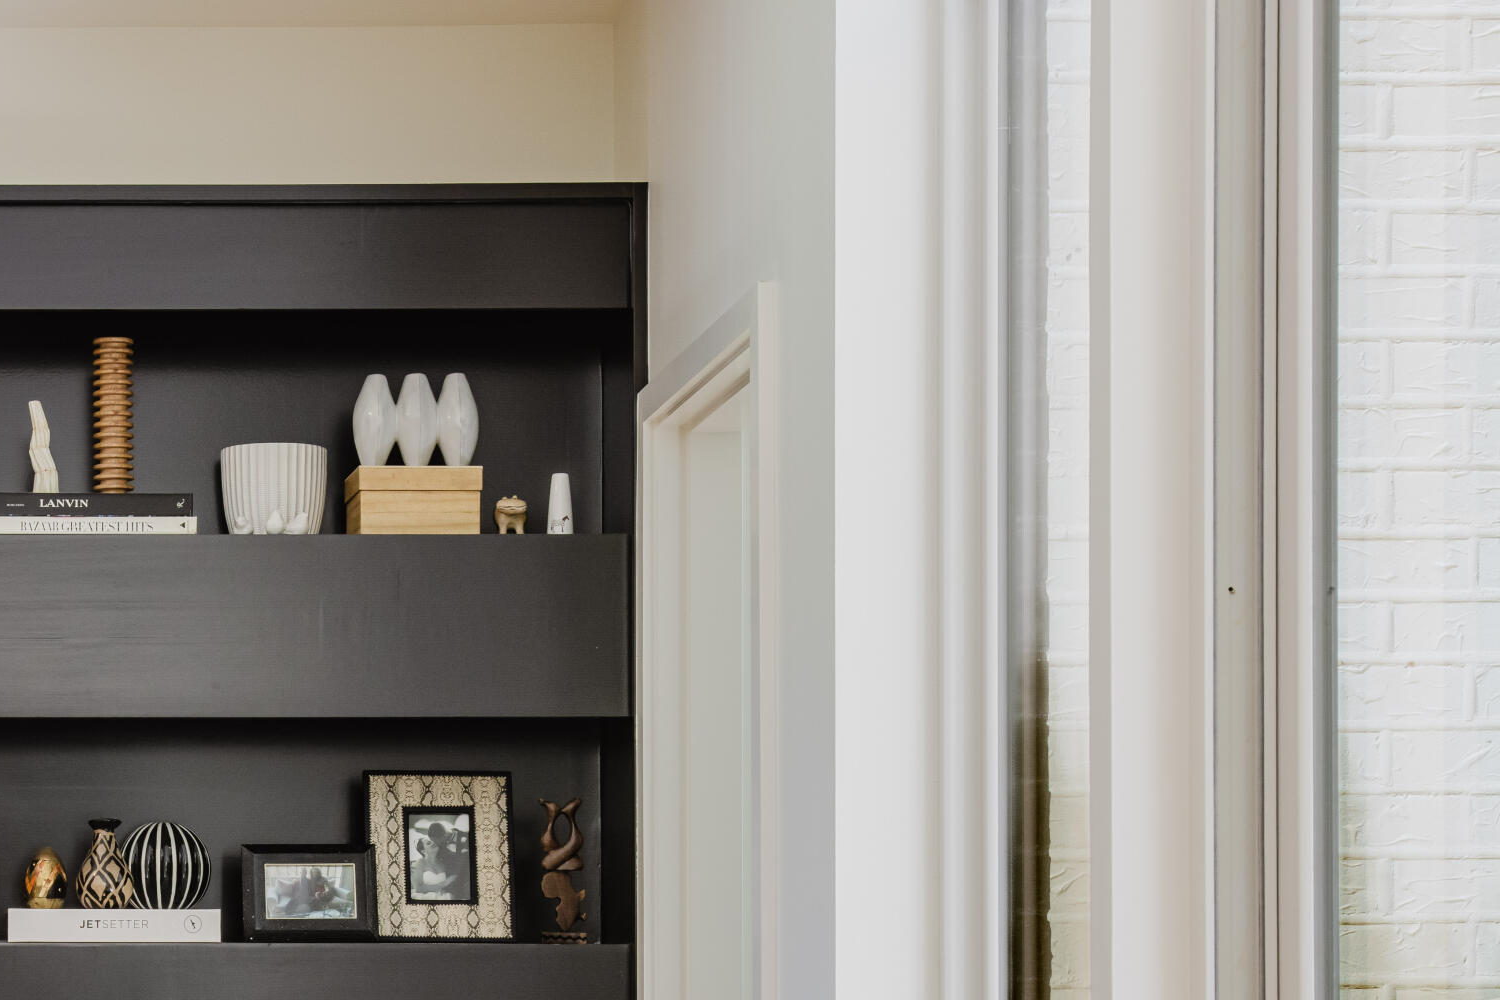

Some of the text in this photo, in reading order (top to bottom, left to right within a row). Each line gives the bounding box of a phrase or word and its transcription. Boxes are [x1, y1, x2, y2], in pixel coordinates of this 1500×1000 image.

[39, 498, 89, 508] LANVIN
[20, 520, 155, 532] BAZAAR GREATEST HITS
[79, 919, 149, 929] JETSETTER
